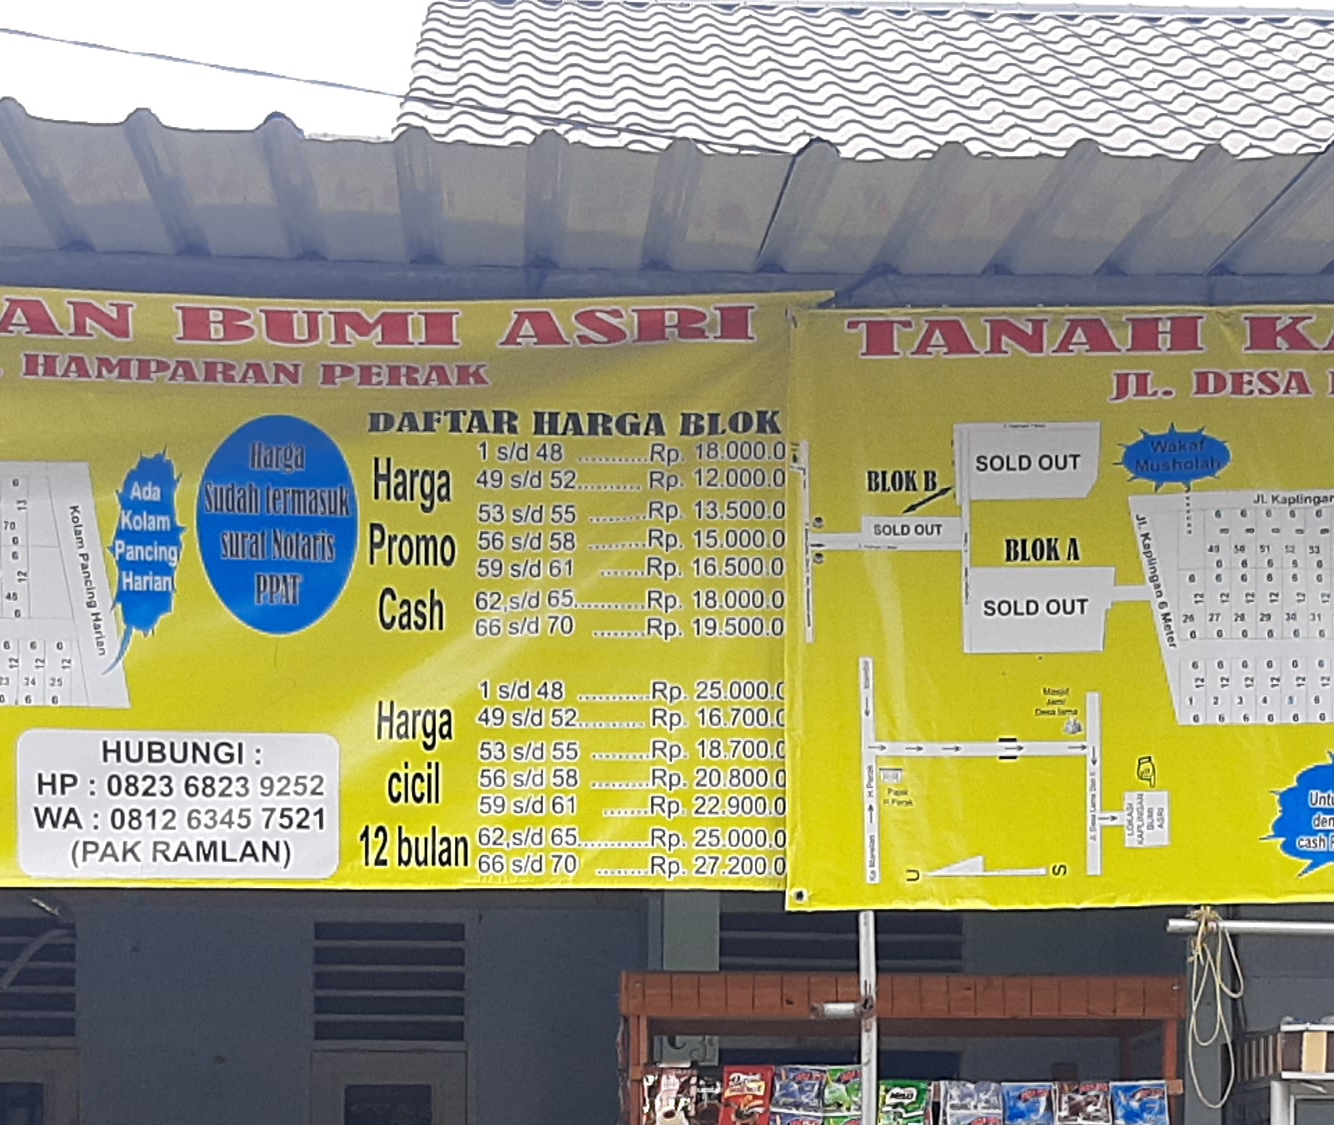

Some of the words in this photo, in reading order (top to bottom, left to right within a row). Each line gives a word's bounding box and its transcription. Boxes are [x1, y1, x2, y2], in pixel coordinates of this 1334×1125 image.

[175, 304, 461, 347] BUMI
[499, 304, 755, 346] ASRI
[846, 314, 1207, 357] TANAH
[22, 353, 301, 385] HAMPARAN
[321, 362, 490, 388] PERAK
[1109, 370, 1175, 402] JL.
[1192, 370, 1313, 397] DESA
[367, 409, 519, 437] DAFTAR
[533, 411, 665, 437] HARGA
[679, 409, 781, 436] BLOK
[249, 441, 305, 473] Harga
[1151, 440, 1205, 453] Wakaf
[975, 454, 1032, 472] SOLD
[1038, 453, 1082, 472] OUT
[1135, 456, 1222, 472] Musholah
[130, 482, 161, 501] Ada
[374, 457, 451, 512] Harga
[868, 469, 917, 492] BLOK
[921, 469, 937, 492] B
[204, 482, 260, 517] Sudah
[265, 484, 350, 517] termasuk
[121, 511, 171, 532] Kolam
[873, 524, 908, 536] SOLD
[911, 524, 943, 536] OUT
[115, 541, 178, 567] Pancing
[220, 531, 267, 560] surat
[272, 531, 335, 562] Notaris
[370, 525, 455, 573] Promo
[1005, 538, 1058, 562] BLOK
[1064, 538, 1081, 562] A
[121, 570, 174, 592] Harian
[254, 575, 300, 605] PPAT
[379, 588, 444, 632] Cash
[982, 600, 1041, 618] SOLD
[1045, 598, 1089, 617] OUT
[377, 701, 452, 751] Harga
[101, 741, 244, 765] HUBUNGI
[37, 773, 79, 796] HP
[107, 775, 173, 797] 0823
[185, 776, 250, 798] 6823
[260, 776, 325, 798] 9252
[388, 762, 439, 805] cicil
[33, 807, 82, 830] WA
[110, 808, 177, 830] 0812
[187, 808, 252, 830] 6345
[262, 808, 325, 830] 7521
[71, 840, 143, 869] (PAK
[152, 841, 292, 869] RAMLAN)
[360, 825, 389, 867] 12
[398, 826, 468, 868] bulan
